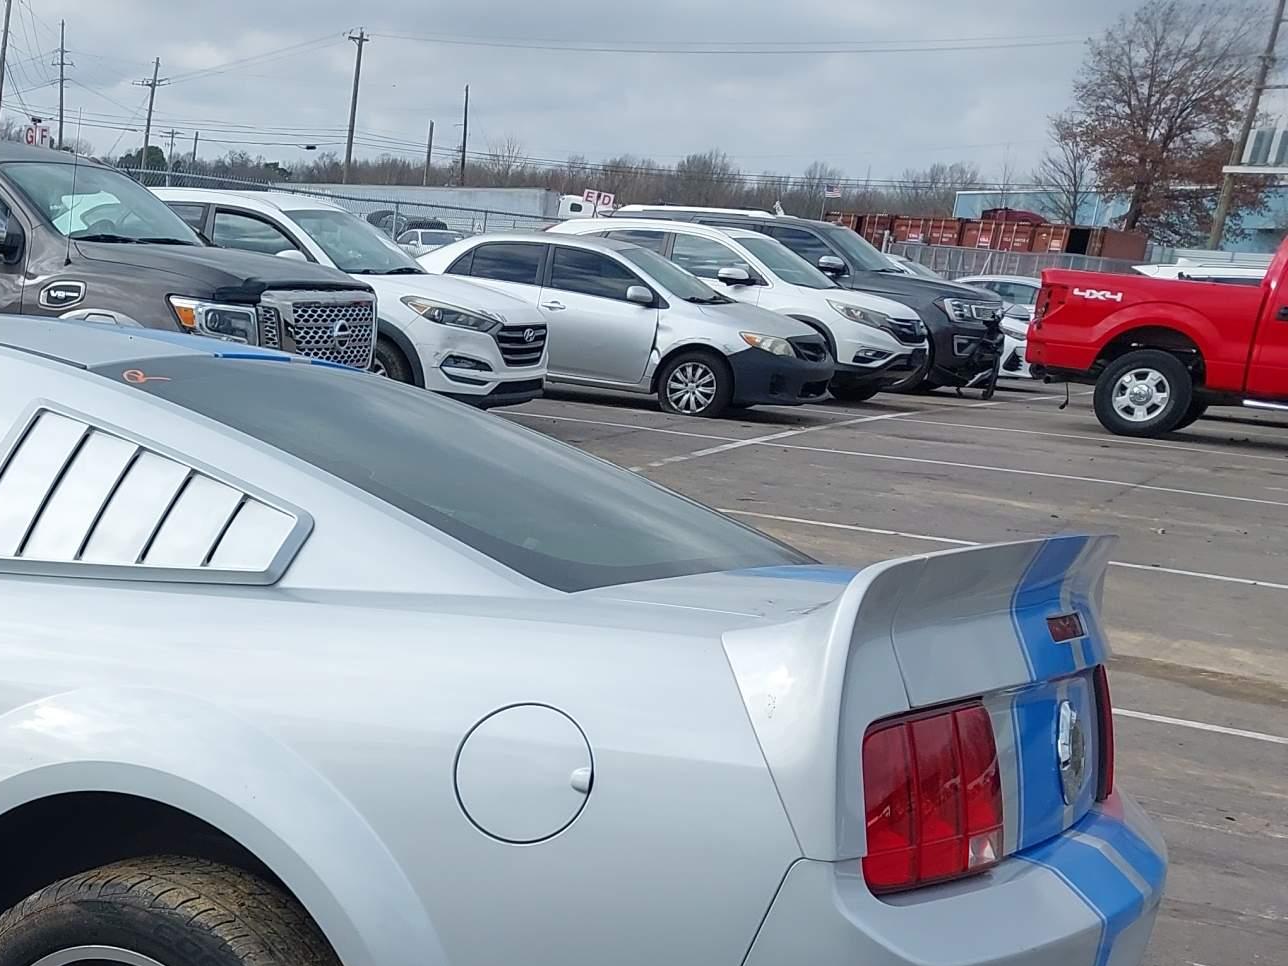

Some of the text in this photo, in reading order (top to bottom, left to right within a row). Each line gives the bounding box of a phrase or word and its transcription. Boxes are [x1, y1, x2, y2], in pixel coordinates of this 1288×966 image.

[25, 127, 34, 145] G
[40, 128, 48, 145] F
[585, 191, 595, 203] E
[602, 194, 612, 206] D
